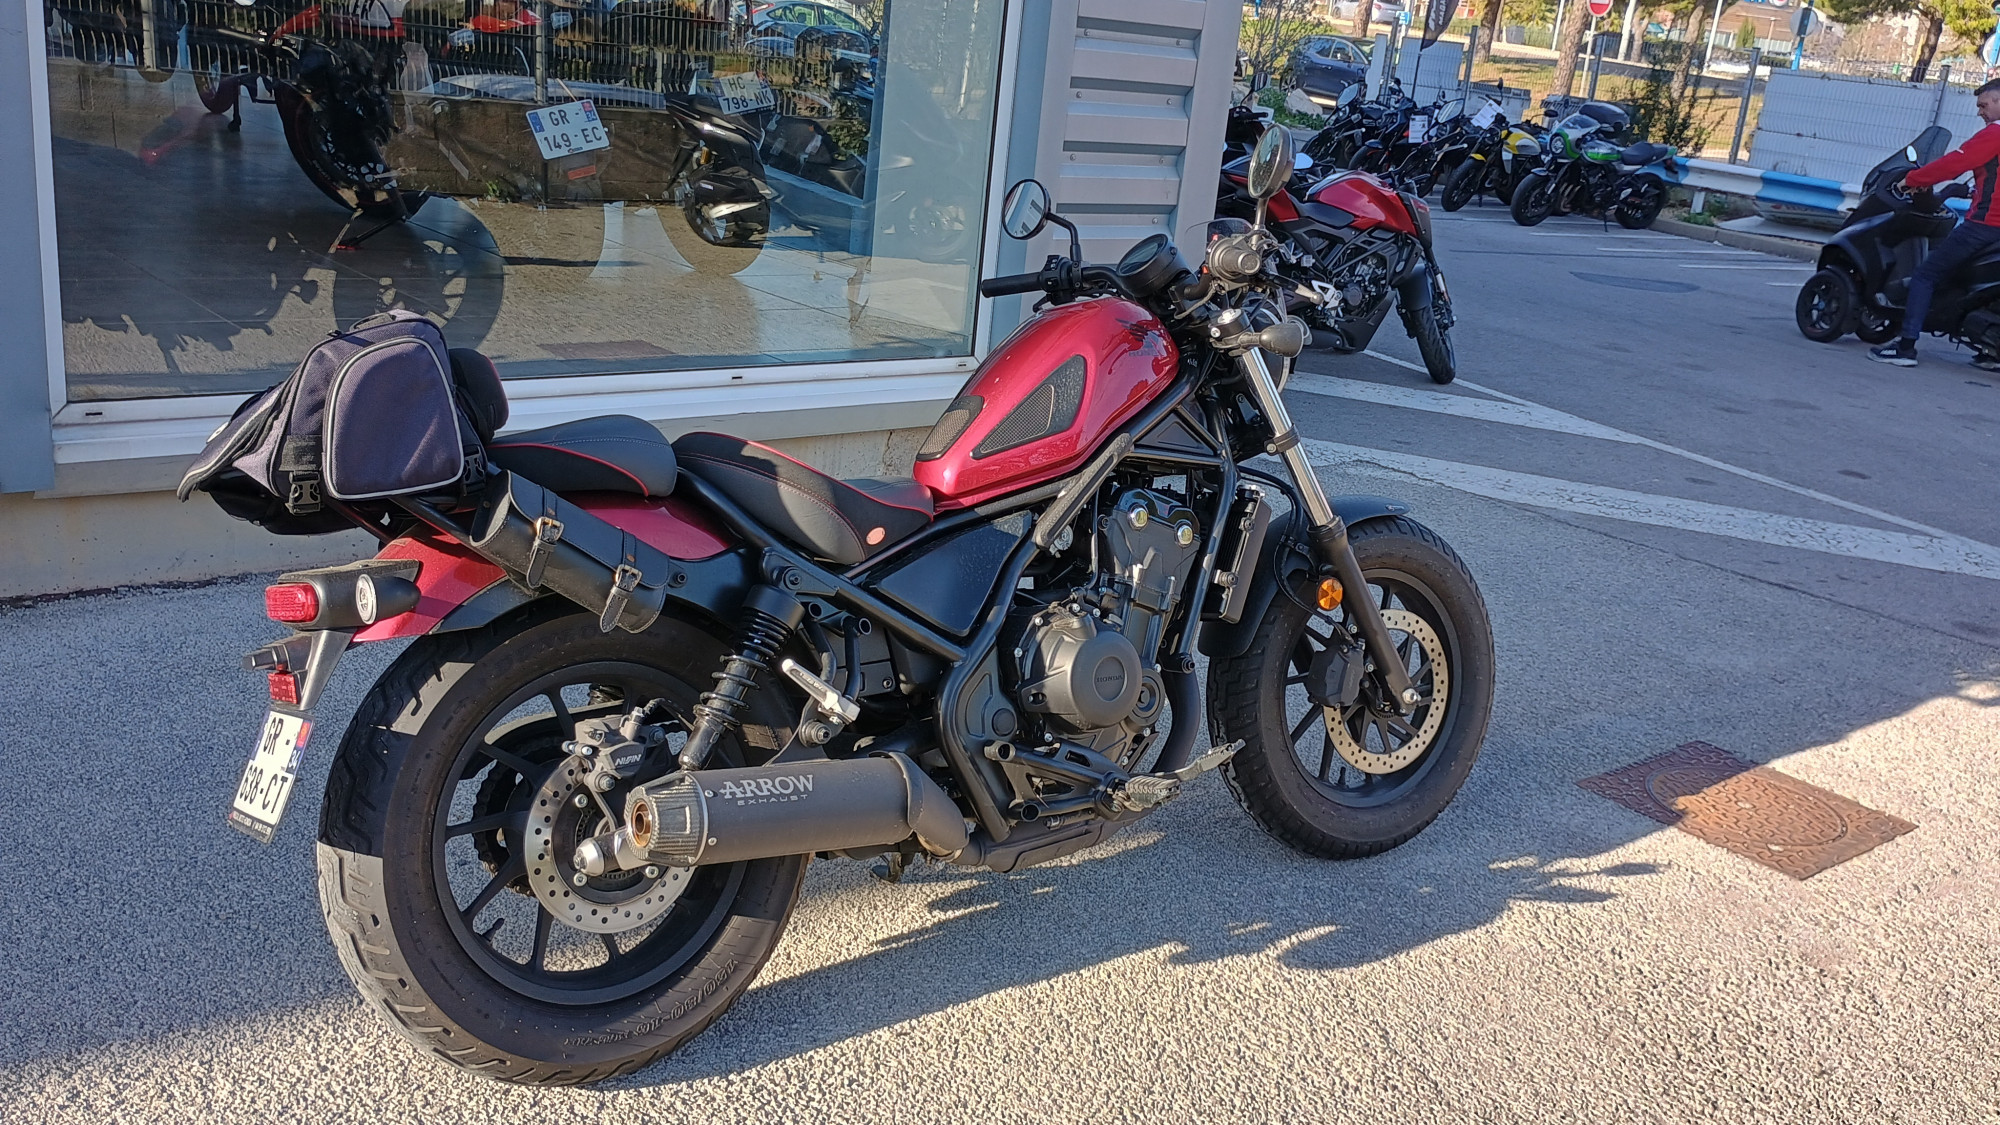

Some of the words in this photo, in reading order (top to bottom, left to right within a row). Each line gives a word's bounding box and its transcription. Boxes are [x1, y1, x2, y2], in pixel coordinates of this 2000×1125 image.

[728, 76, 746, 91] HC
[549, 109, 570, 126] GR
[1096, 674, 1123, 683] HONDA
[263, 716, 284, 755] GR
[719, 774, 814, 799] ARROW
[737, 794, 808, 806] EXHAUST
